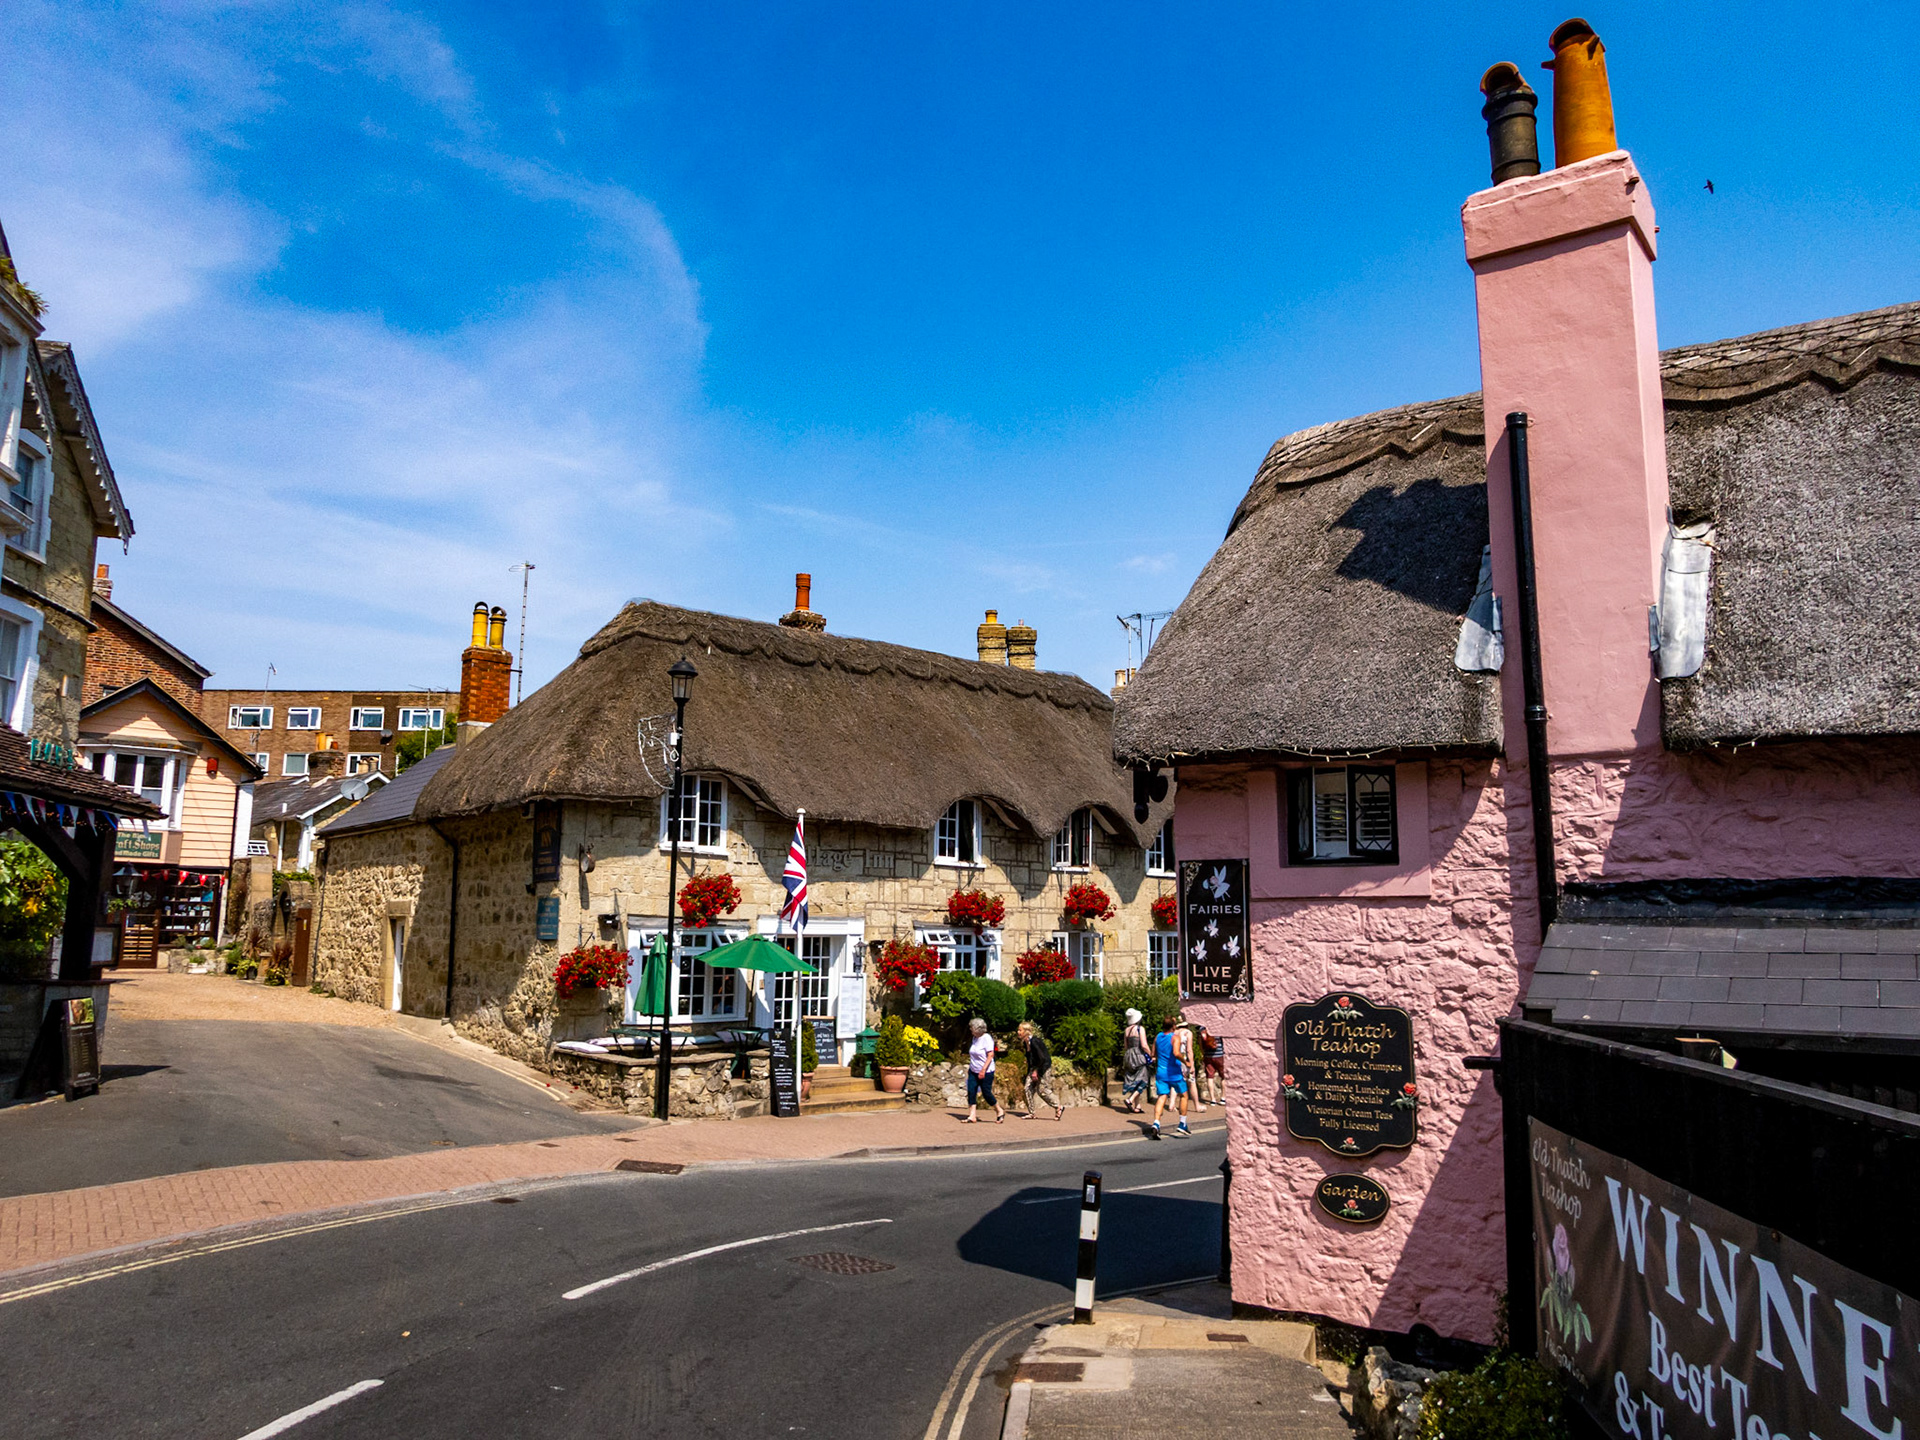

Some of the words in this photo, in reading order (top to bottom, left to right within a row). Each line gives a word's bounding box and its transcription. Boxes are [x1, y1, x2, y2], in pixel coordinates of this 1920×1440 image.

[865, 849, 894, 869] Inn
[1189, 903, 1242, 914] FAIRIES
[1192, 963, 1232, 978] LIVE
[1193, 981, 1230, 993] HERE
[1294, 1020, 1329, 1036] Old
[1331, 1021, 1397, 1039] Thatch
[1310, 1036, 1381, 1059] Teashop
[1294, 1057, 1329, 1070] Morning
[1361, 1061, 1403, 1073] Crumpets
[1324, 1070, 1332, 1079] &
[1334, 1070, 1372, 1081] Teacakes
[1307, 1081, 1353, 1093] Homemade
[1355, 1084, 1390, 1095] Lunches
[1314, 1091, 1323, 1100] &
[1325, 1091, 1347, 1104] Daily
[1349, 1094, 1384, 1105] Specials
[1306, 1104, 1343, 1116] Victorian
[1345, 1107, 1373, 1119] Cream
[1374, 1109, 1394, 1120] Teas
[1319, 1117, 1341, 1130] Fully
[1342, 1119, 1380, 1132] Licensed
[1533, 1137, 1551, 1168] Old
[1550, 1146, 1591, 1190] Thatch
[1321, 1182, 1382, 1202] Garden
[1540, 1172, 1582, 1229] Teashop
[1604, 1175, 1920, 1440] WINNE
[1648, 1311, 1716, 1428] Best
[1614, 1371, 1643, 1440] &
